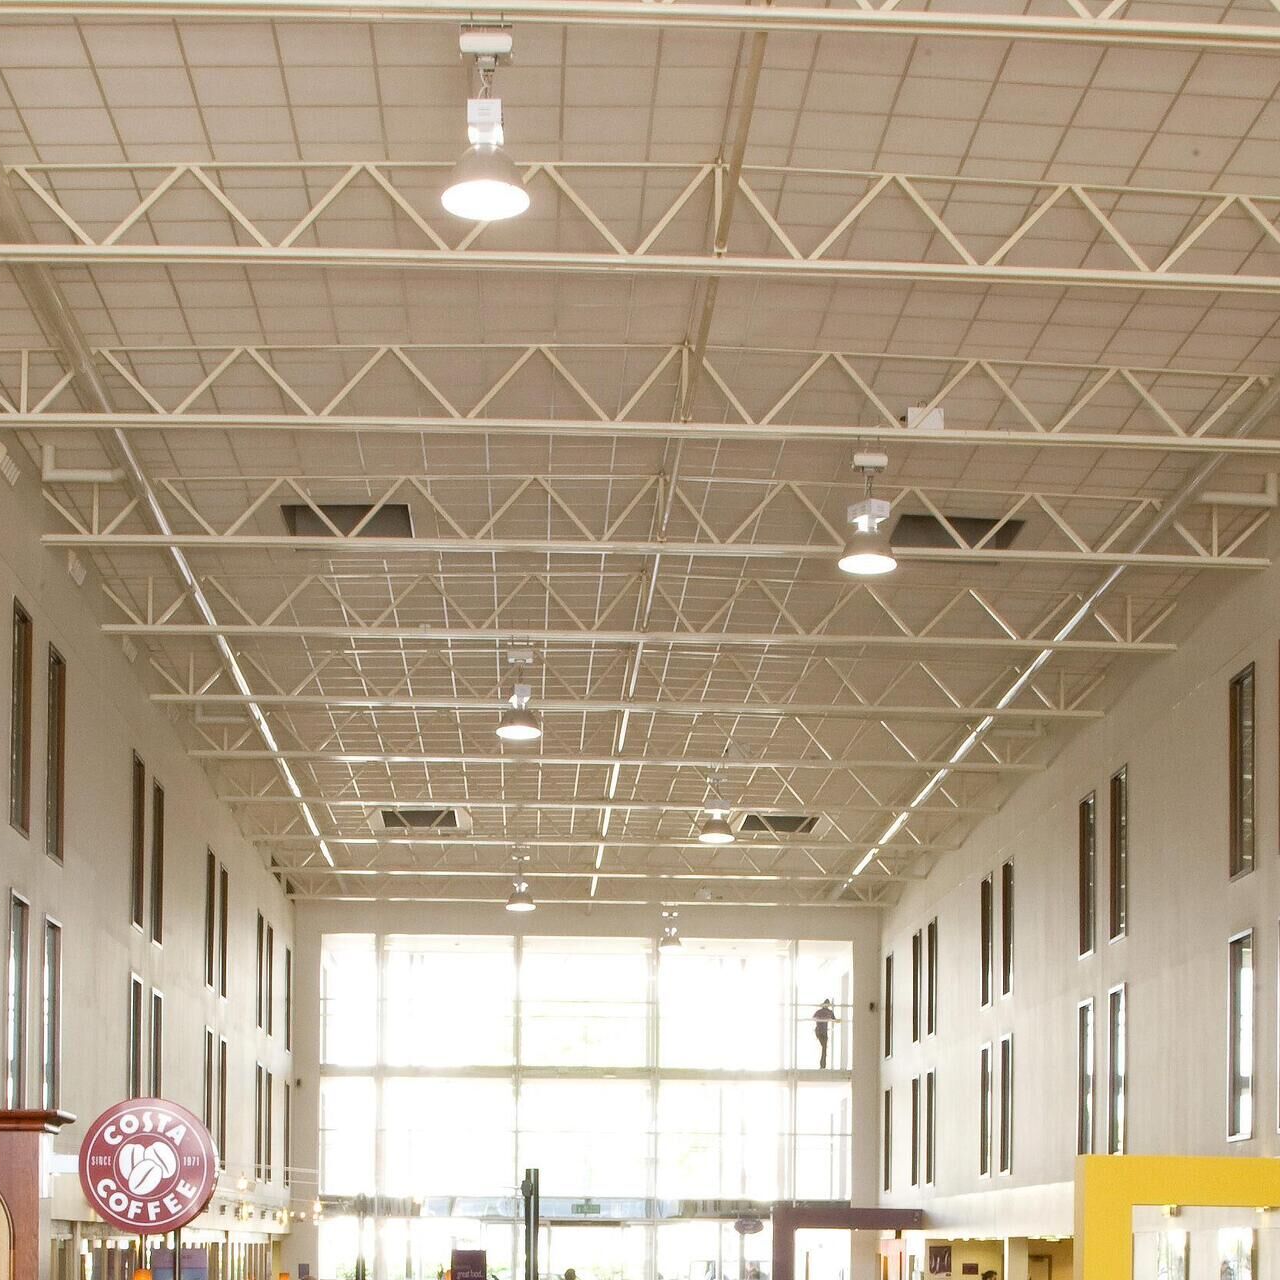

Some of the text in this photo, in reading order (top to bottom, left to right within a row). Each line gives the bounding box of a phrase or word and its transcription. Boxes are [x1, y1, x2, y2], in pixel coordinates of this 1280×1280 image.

[103, 1110, 187, 1146] COSTA
[91, 1155, 200, 1167] SINCE 1971
[96, 1178, 197, 1221] COFFEE
